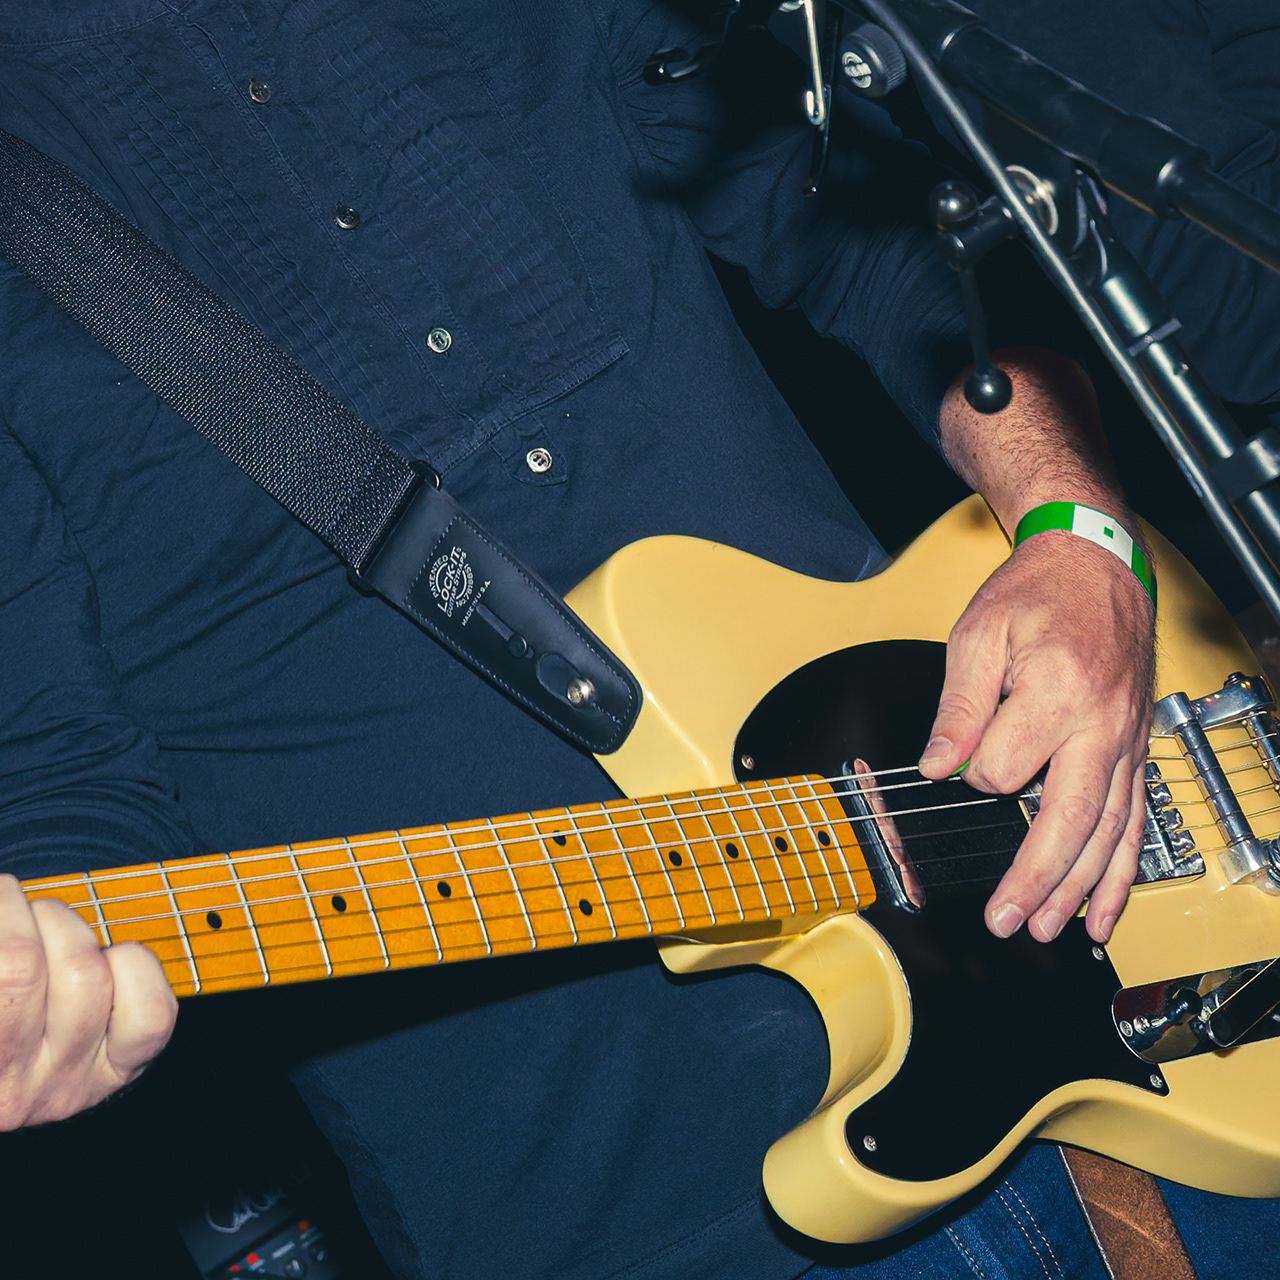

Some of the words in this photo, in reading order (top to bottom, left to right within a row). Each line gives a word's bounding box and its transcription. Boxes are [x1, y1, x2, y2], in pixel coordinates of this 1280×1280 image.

[429, 554, 449, 598] PATENTED
[446, 585, 458, 618] GUITAR
[453, 551, 467, 586] STRAPS
[461, 606, 475, 627] MADE
